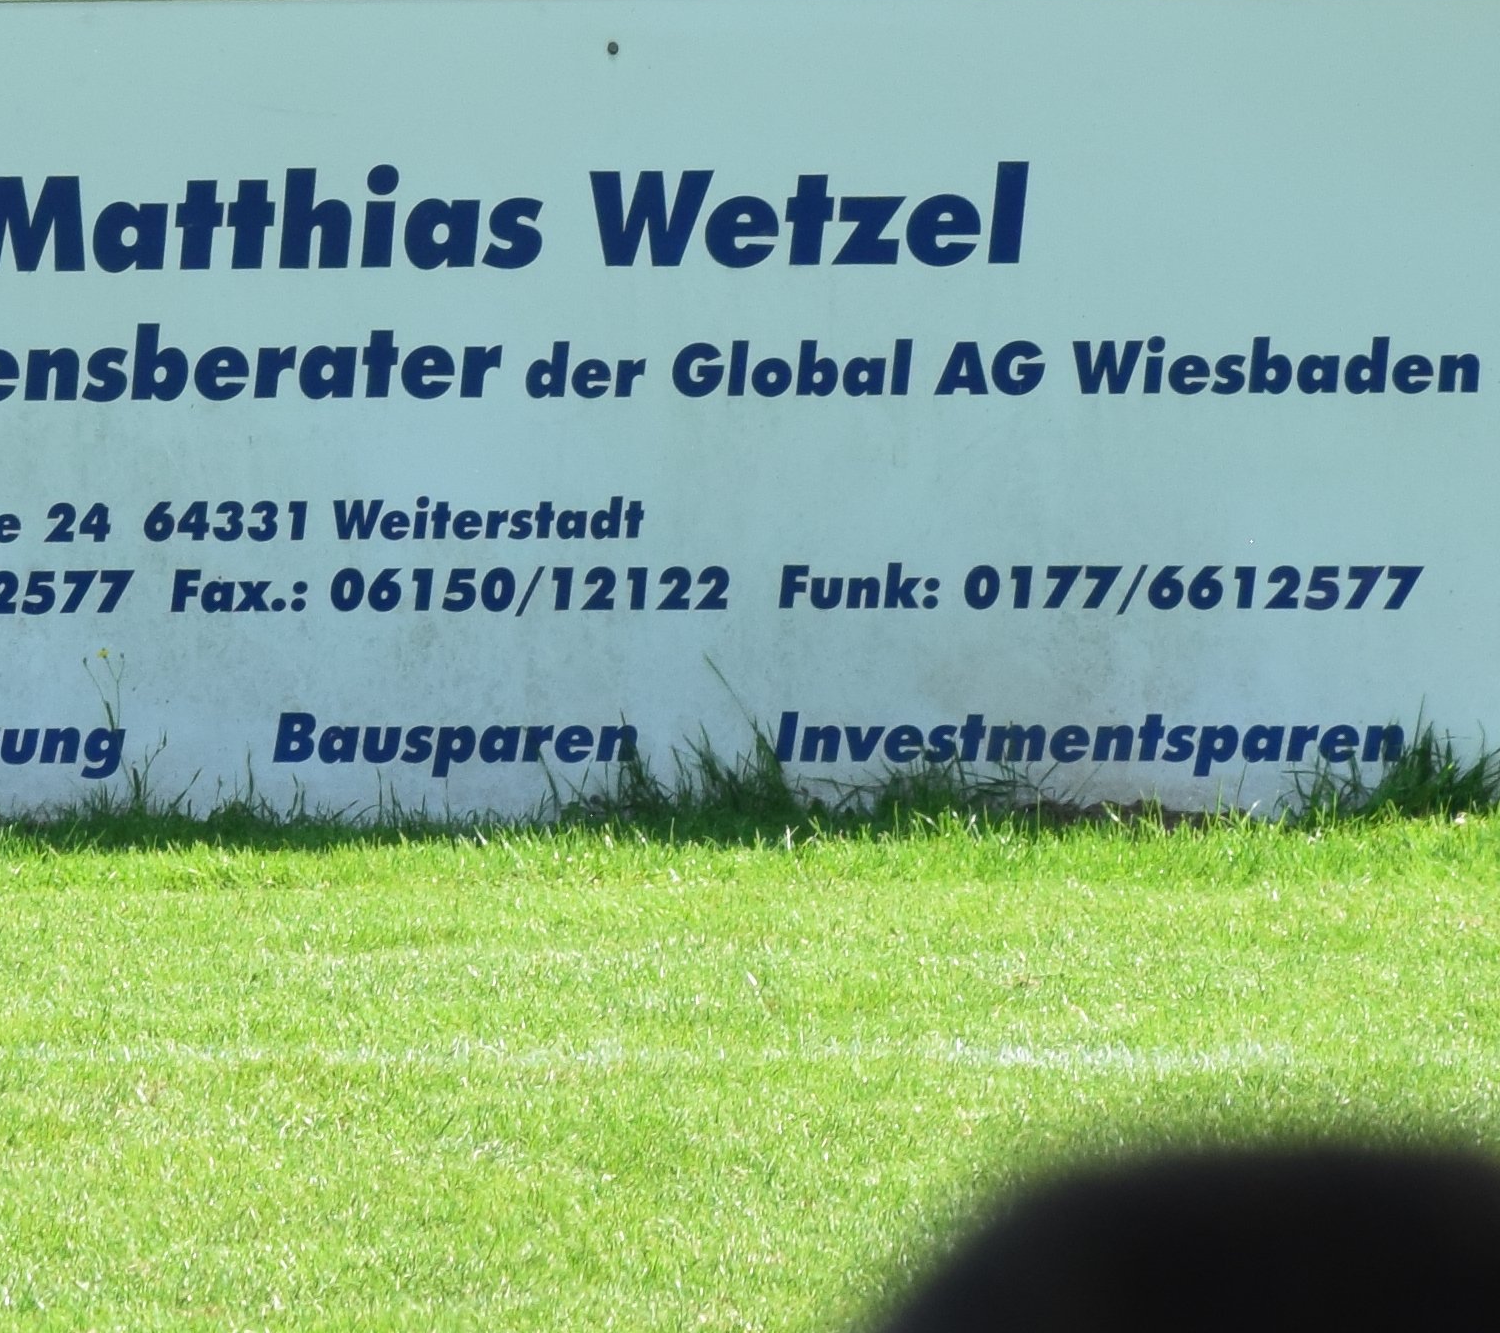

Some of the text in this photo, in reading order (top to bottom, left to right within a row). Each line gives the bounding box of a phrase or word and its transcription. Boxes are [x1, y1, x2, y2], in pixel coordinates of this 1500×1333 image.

[591, 162, 1029, 268] Wetzel
[527, 342, 646, 399] der
[673, 338, 913, 398] Global
[935, 341, 1046, 396] AG
[1074, 336, 1480, 395] Wiesbaden
[44, 502, 112, 543] 24
[143, 500, 308, 543] 64331
[333, 496, 645, 541] Weiterstadt
[171, 569, 308, 614] Fax.:
[330, 565, 730, 615] 06150/12122
[779, 563, 941, 610] Funk:
[965, 564, 1424, 614] 0177/6612577
[272, 711, 638, 778] Bausparen
[776, 711, 1405, 778] Investmentsparen
